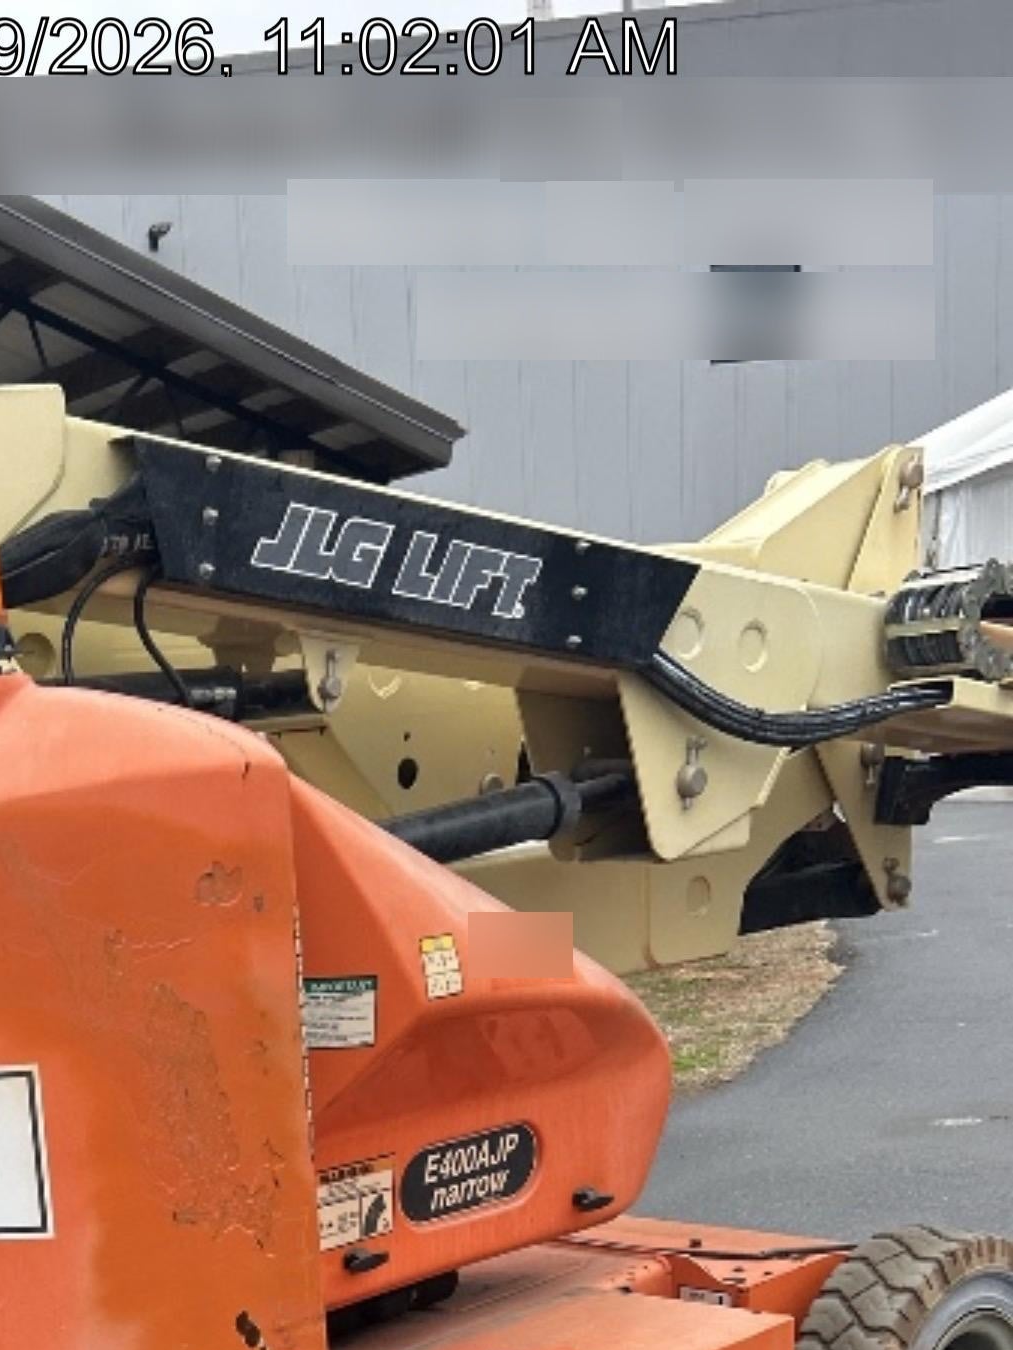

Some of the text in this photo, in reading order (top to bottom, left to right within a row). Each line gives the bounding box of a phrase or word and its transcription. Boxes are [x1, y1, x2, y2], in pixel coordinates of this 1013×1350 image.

[251, 501, 543, 619] JLG LIFT
[424, 1132, 520, 1185] E400AJP
[430, 1169, 510, 1213] narrow
